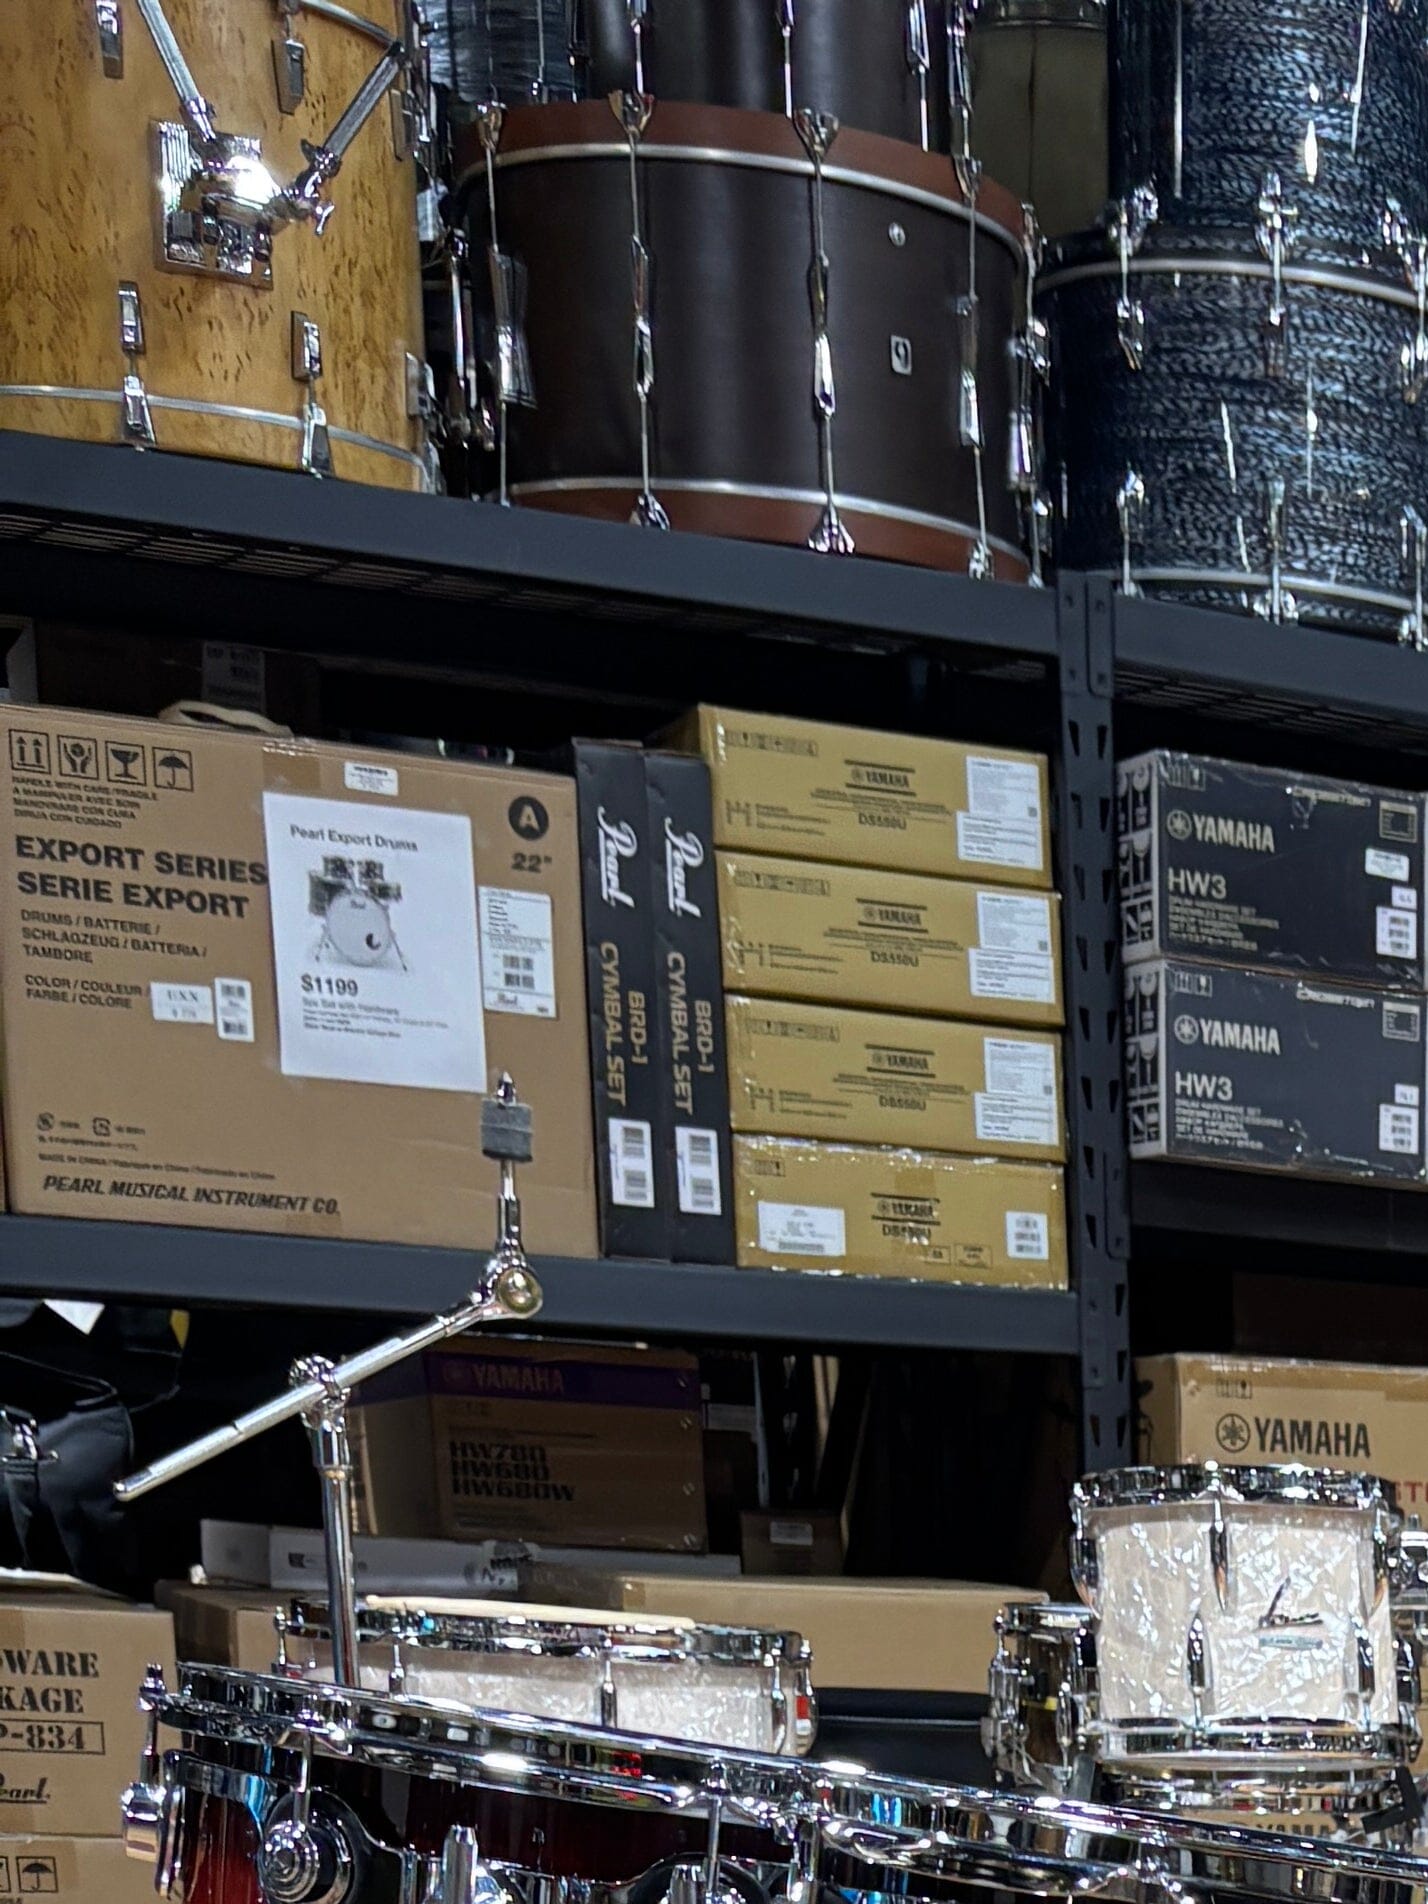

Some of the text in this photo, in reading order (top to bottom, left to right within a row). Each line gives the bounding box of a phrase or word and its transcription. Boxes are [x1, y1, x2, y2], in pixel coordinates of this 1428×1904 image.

[290, 824, 419, 852] Pearl Export Drums
[1192, 812, 1275, 853] YAMAHA
[15, 834, 269, 885] EXPORT SERIES
[597, 805, 638, 909] Pearl
[664, 816, 704, 919] Pearl
[17, 870, 249, 918] SERIE EXPORT
[1168, 866, 1227, 900] HW3
[21, 909, 73, 926] DRUMS
[300, 973, 359, 997] $1199
[601, 941, 626, 1107] CYMBAL SET
[666, 951, 693, 1116] CYMBAL SET
[1200, 1018, 1281, 1056] YAMAHA
[1174, 1070, 1233, 1101] HW3
[43, 1174, 105, 1196] PEARL
[109, 1179, 190, 1203] MUSICAL
[193, 1186, 309, 1213] INSTRUMENT
[472, 1362, 565, 1393] YAMAHA
[1254, 1417, 1371, 1458] YAMAHA
[0, 1649, 100, 1678] WARE
